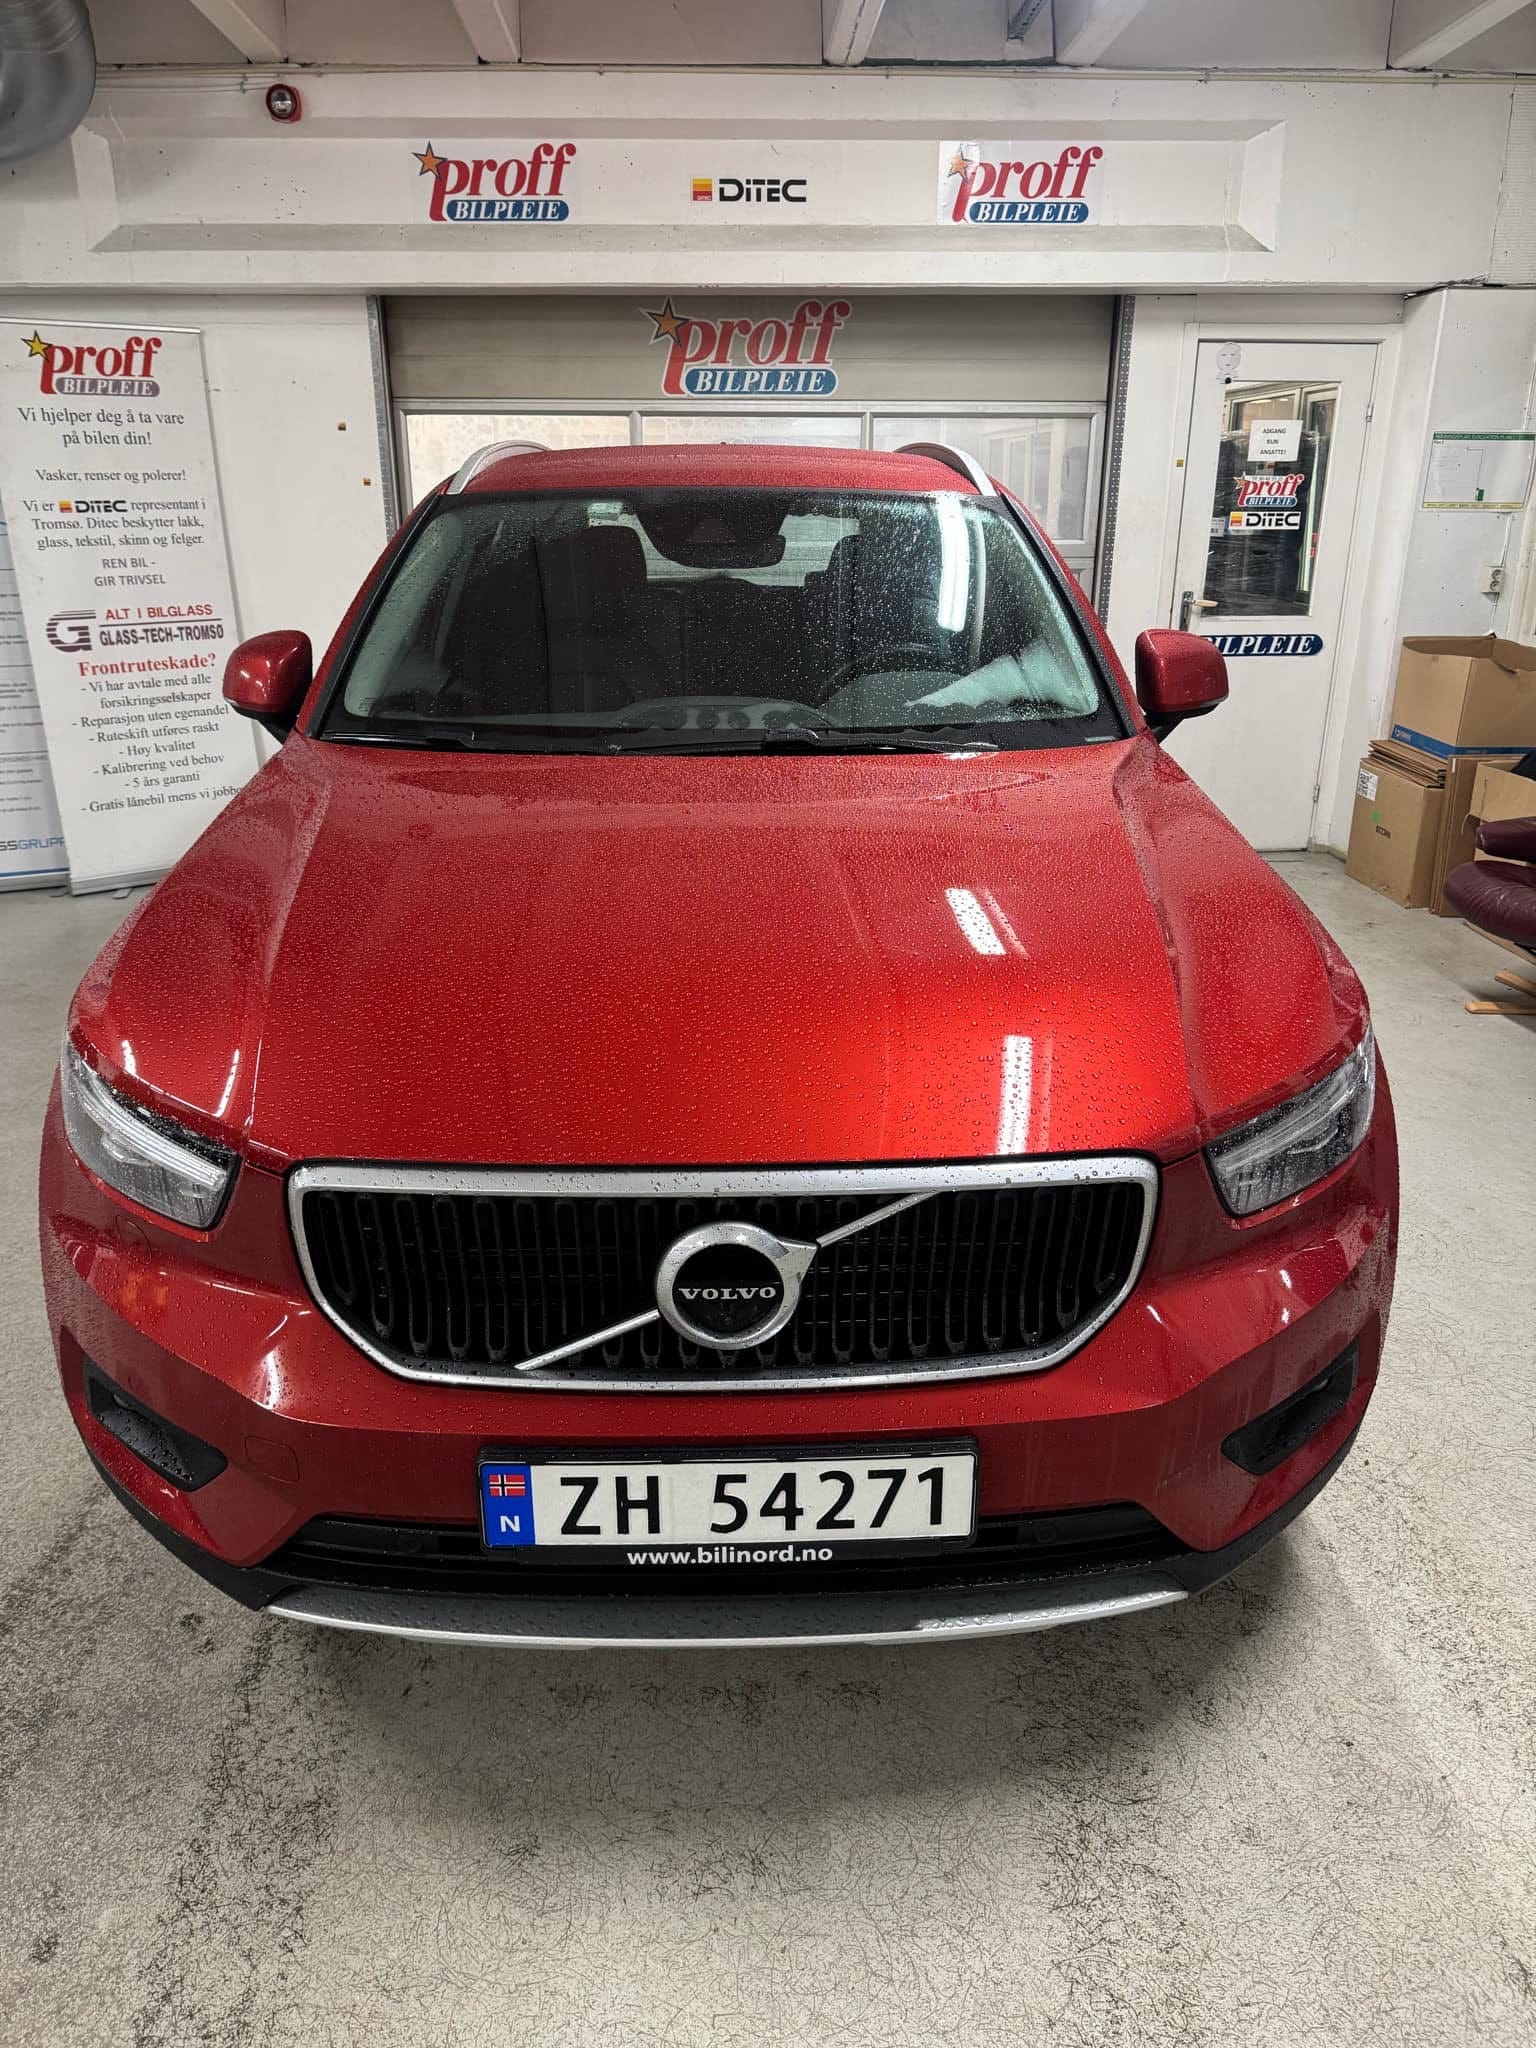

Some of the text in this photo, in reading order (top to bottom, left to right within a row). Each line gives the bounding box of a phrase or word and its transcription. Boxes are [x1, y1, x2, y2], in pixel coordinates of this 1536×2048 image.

[429, 143, 577, 221] proff
[952, 146, 1103, 222] proff
[454, 201, 561, 220] BILPLEIE
[975, 203, 1081, 221] BILPLEIE
[663, 300, 850, 395] proff
[40, 336, 162, 394] proff
[63, 378, 153, 396] BILPLEIE
[694, 370, 826, 392] BILPLEIE
[18, 407, 184, 426] Vi hjelper deg å ta vare
[62, 430, 152, 448] på bilen din!
[35, 469, 186, 483] Vasker, renser og polerer!
[1239, 475, 1303, 505] proff
[23, 499, 38, 512] Vi
[42, 502, 54, 512] er
[131, 498, 199, 514] representant
[202, 498, 206, 510] i
[87, 517, 118, 529] Ditec
[122, 516, 174, 531] beskytter
[37, 533, 205, 551] glass, tekstil, skinn og felger.
[102, 558, 127, 569] REN
[131, 557, 149, 568] BIL
[94, 574, 166, 587] GIR TRIVSEL
[106, 604, 213, 620] ALT I BILGLASS
[1206, 635, 1315, 655] ILPLEIE
[78, 653, 216, 677] Frontruteskade?
[89, 681, 103, 692] Vi
[106, 680, 124, 691] har
[128, 677, 162, 690] avtale
[164, 675, 188, 687] med
[191, 673, 212, 685] alle
[100, 691, 212, 709] forsikringsselskaper
[80, 713, 145, 729] Reparasjon
[148, 711, 171, 722] uten
[174, 704, 229, 720] egenandel
[97, 728, 150, 743] Ruteskift
[192, 721, 220, 733] raskt
[154, 741, 195, 754] kvalitet
[102, 760, 167, 776] Kalibrering
[169, 756, 189, 767] ved
[191, 753, 225, 765] behov
[133, 777, 140, 788] 5
[143, 774, 160, 787] års
[162, 771, 201, 785] garanti
[89, 799, 124, 813] Gratis
[127, 794, 165, 808] lånebil
[168, 791, 197, 803] mens
[200, 788, 210, 799] vi
[678, 1287, 776, 1300] VOLVO
[560, 1467, 944, 1535] ZH 54271
[501, 1515, 520, 1533] N
[627, 1544, 833, 1566] www.bilinord.no
